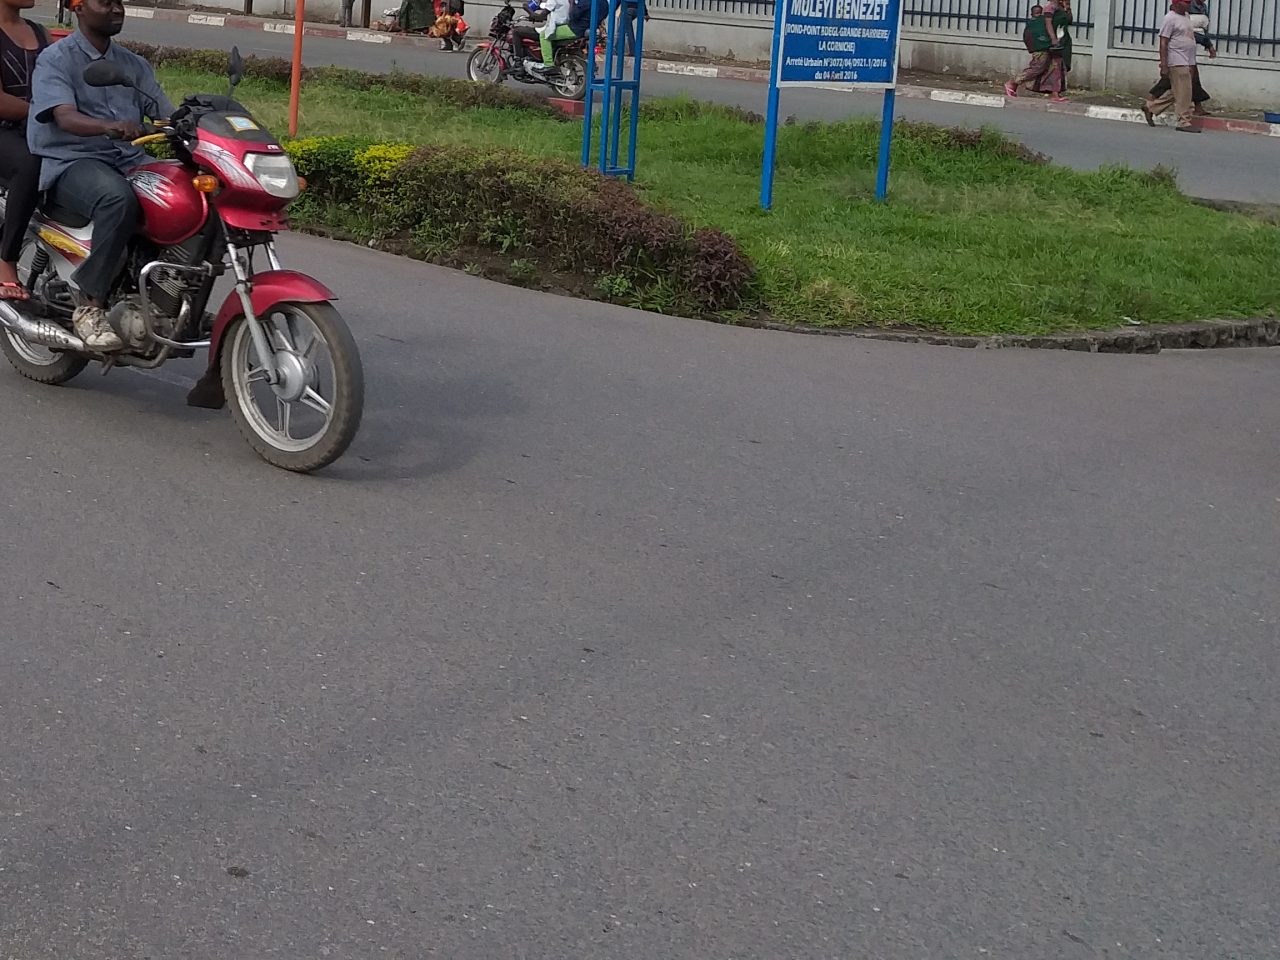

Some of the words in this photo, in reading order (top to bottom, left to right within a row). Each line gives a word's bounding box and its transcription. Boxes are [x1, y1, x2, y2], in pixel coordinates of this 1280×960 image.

[818, 41, 827, 51] LA
[803, 57, 823, 67] Urbain
[814, 71, 822, 80] du
[844, 72, 858, 80] 2016
